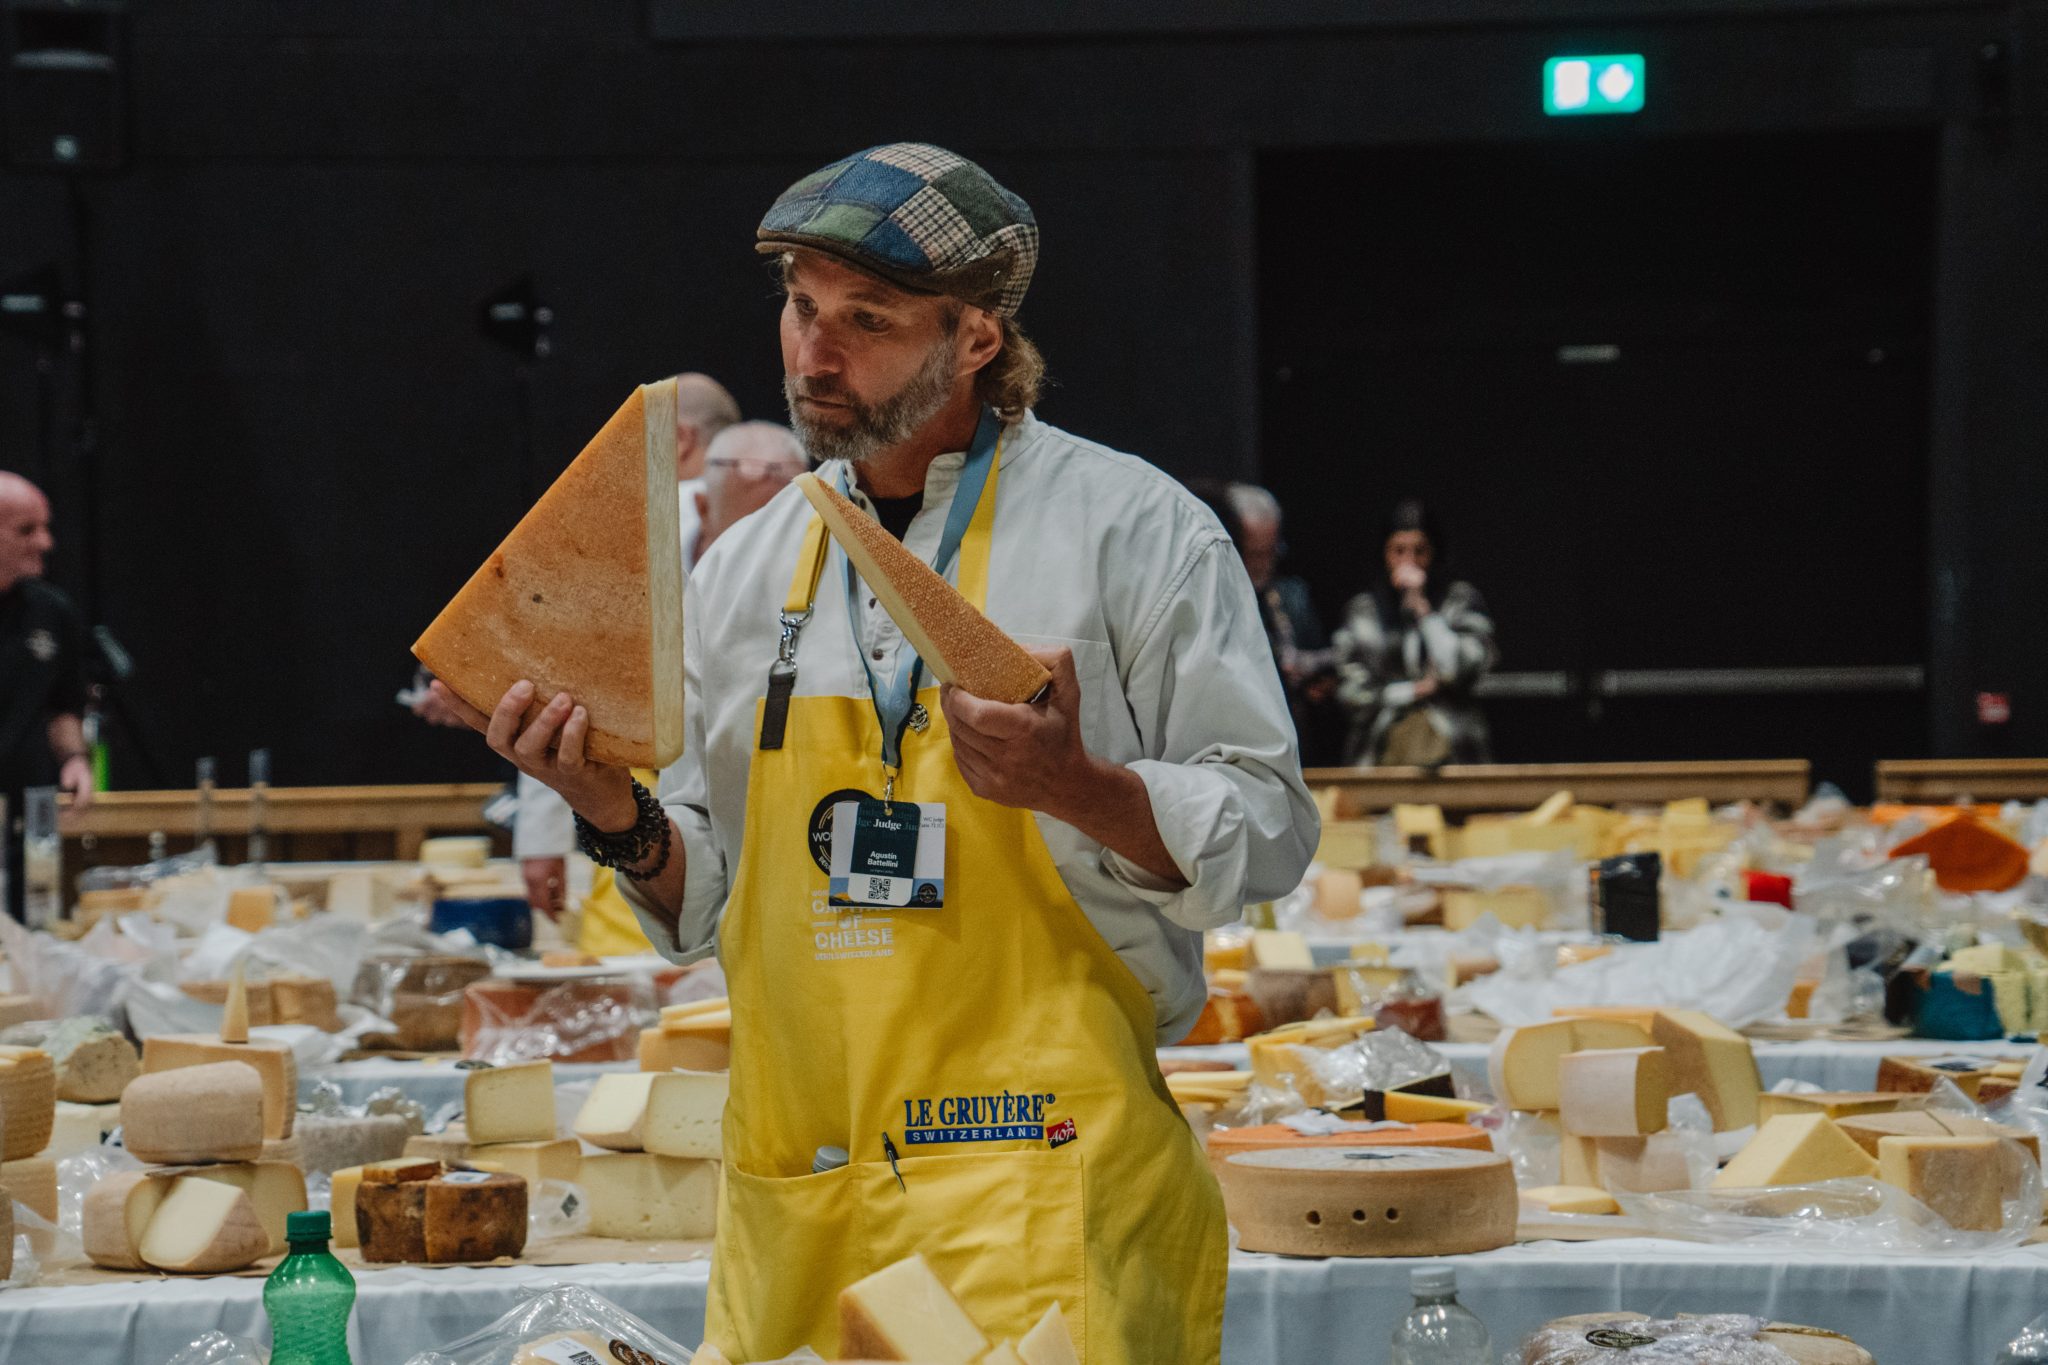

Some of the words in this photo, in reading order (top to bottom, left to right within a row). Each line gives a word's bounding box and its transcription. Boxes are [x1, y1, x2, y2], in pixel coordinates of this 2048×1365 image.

[873, 818, 902, 831] Judge
[867, 858, 899, 868] Battellini
[814, 927, 894, 950] CHEESE
[904, 1099, 934, 1127] LE
[912, 1127, 1039, 1142] SWITZERLAND
[1048, 1127, 1075, 1143] AOP
